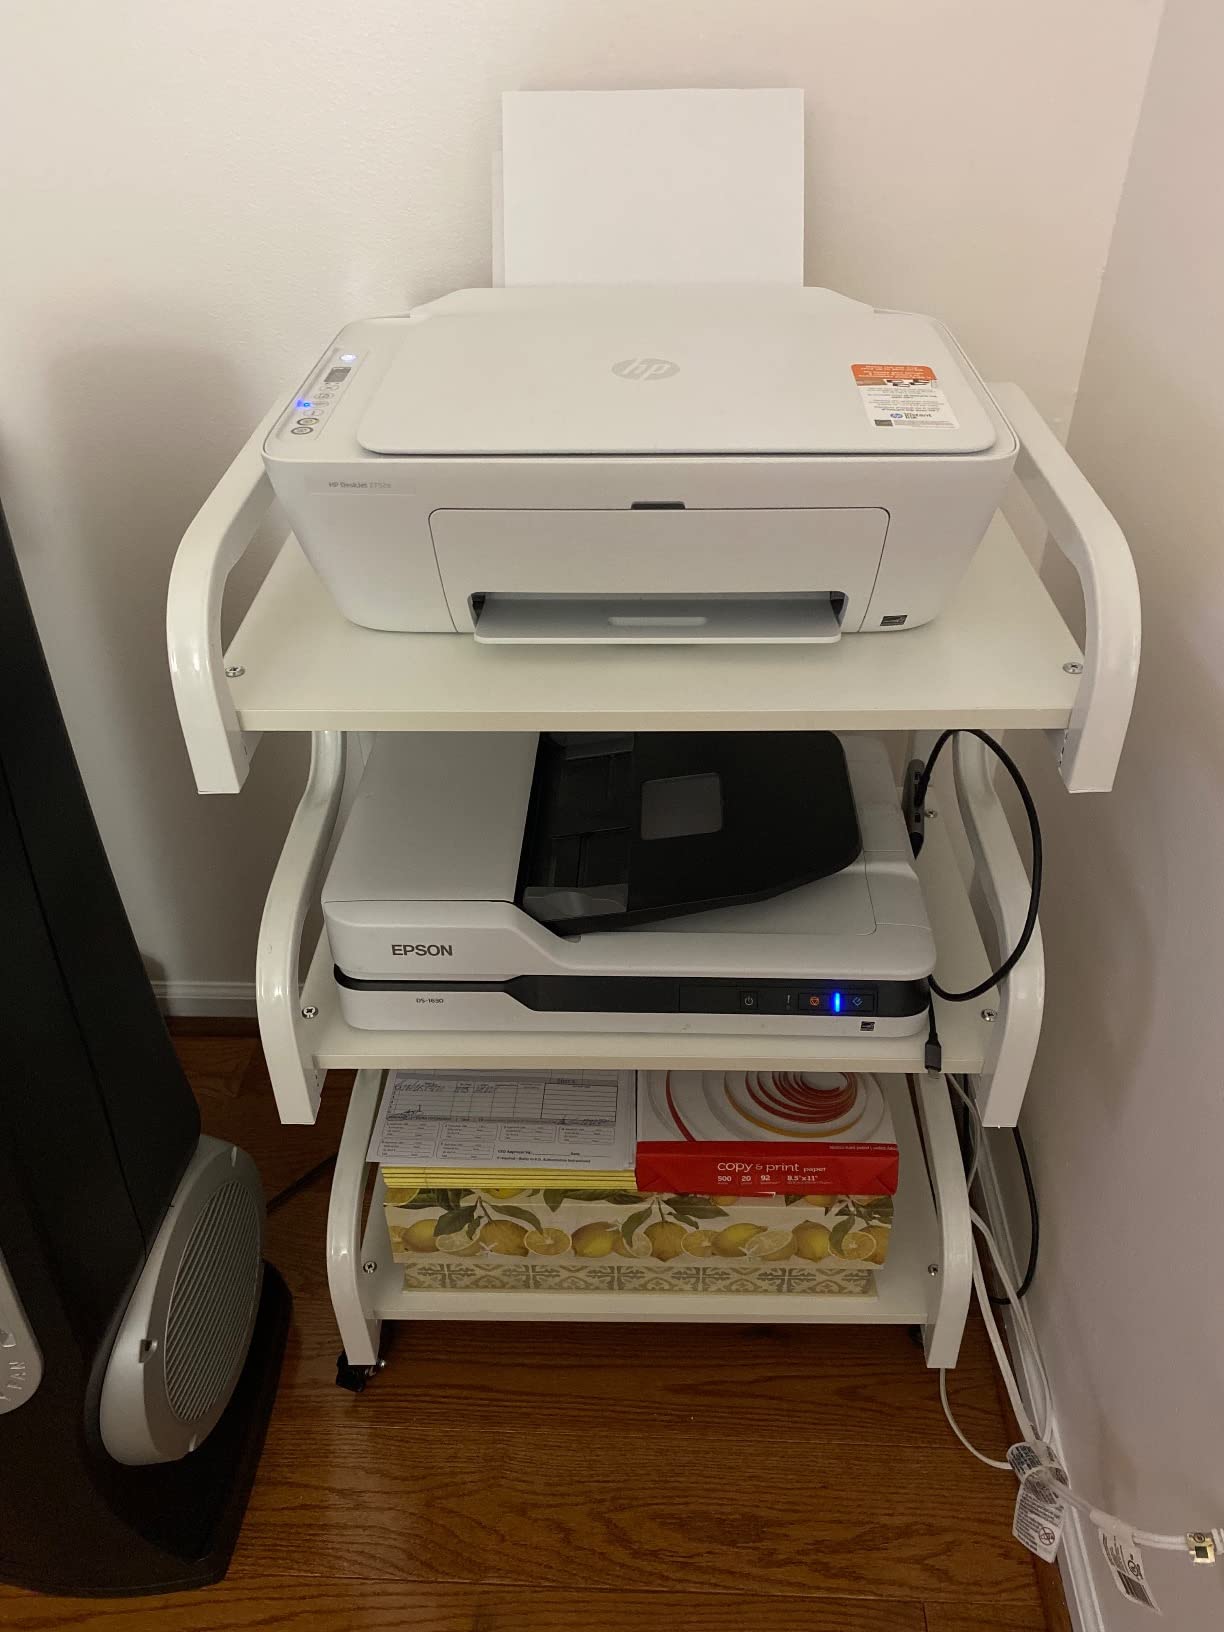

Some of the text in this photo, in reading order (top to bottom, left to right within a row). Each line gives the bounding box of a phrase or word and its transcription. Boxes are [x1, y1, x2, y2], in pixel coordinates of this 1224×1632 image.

[391, 944, 453, 956] EPSON
[717, 1162, 753, 1173] copy
[755, 1163, 763, 1171] &
[766, 1162, 800, 1173] print
